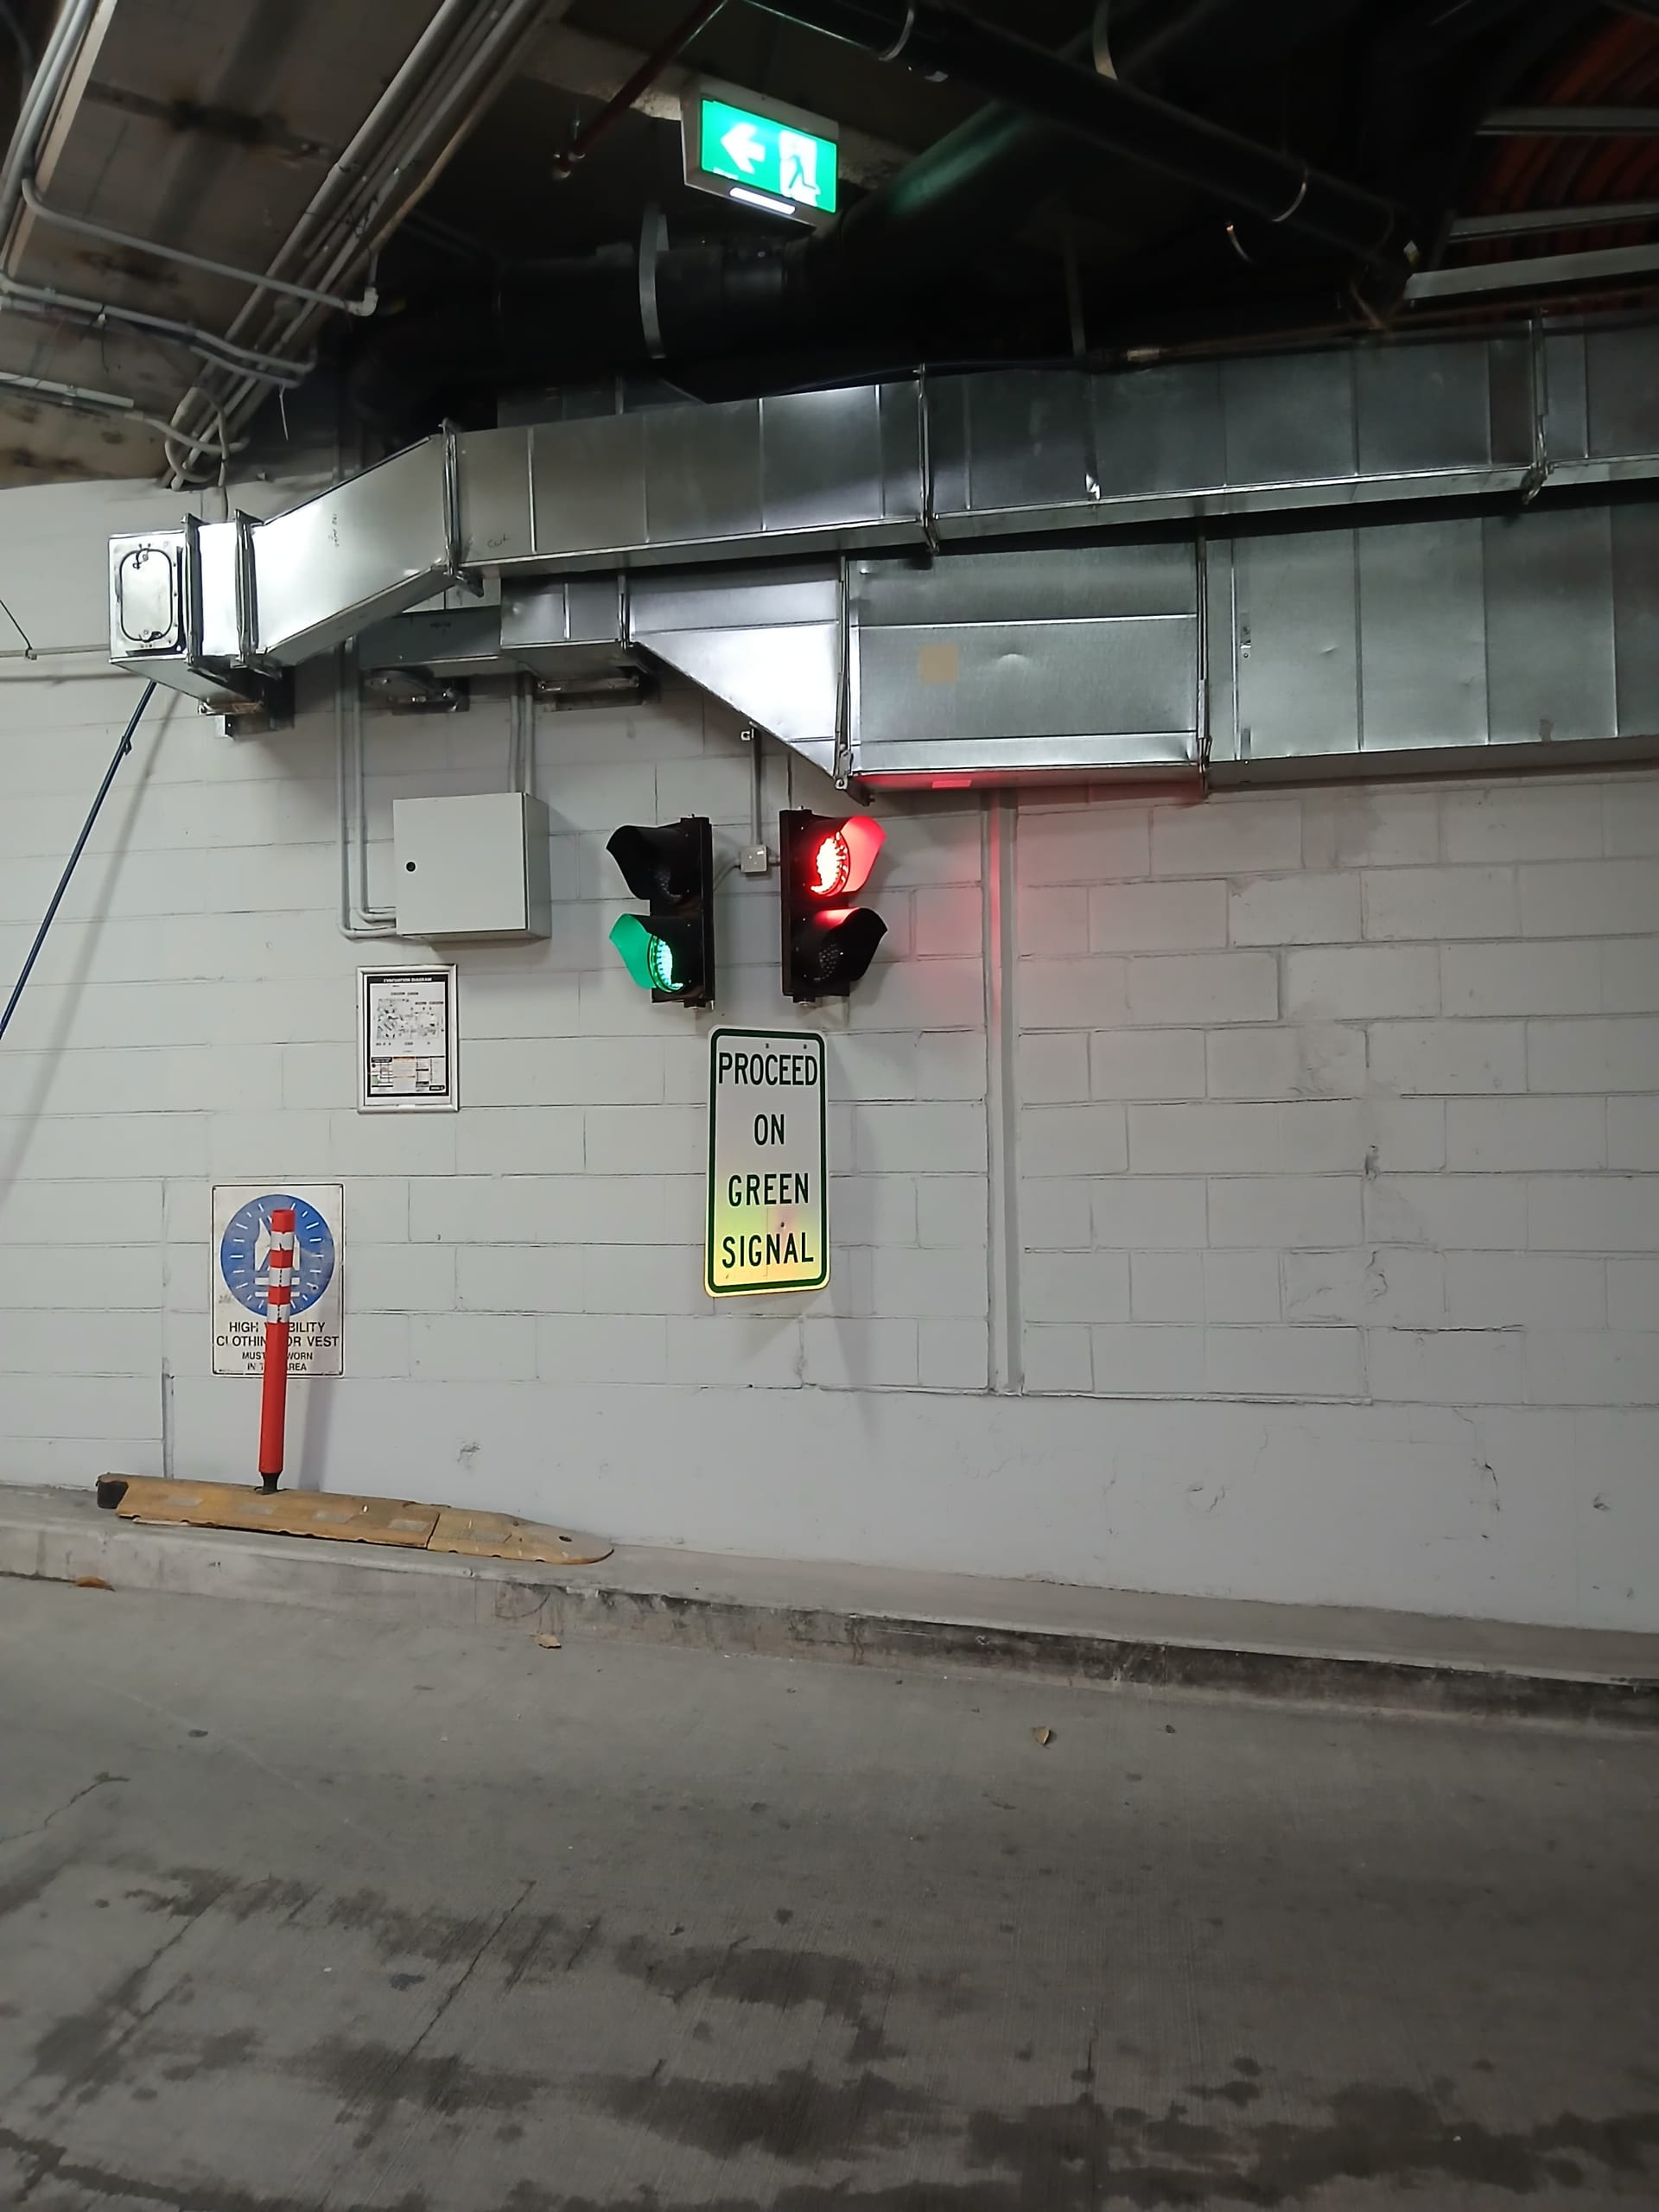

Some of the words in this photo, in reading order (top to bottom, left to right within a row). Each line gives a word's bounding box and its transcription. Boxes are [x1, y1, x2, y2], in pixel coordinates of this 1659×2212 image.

[719, 1052, 818, 1086] PROCEED
[753, 1113, 785, 1145] ON
[728, 1173, 809, 1207] GREEN
[721, 1232, 814, 1268] SIGNAL
[216, 1336, 267, 1346] CLOTHIN
[307, 1336, 340, 1347] VEST
[229, 1322, 258, 1332] HIGH
